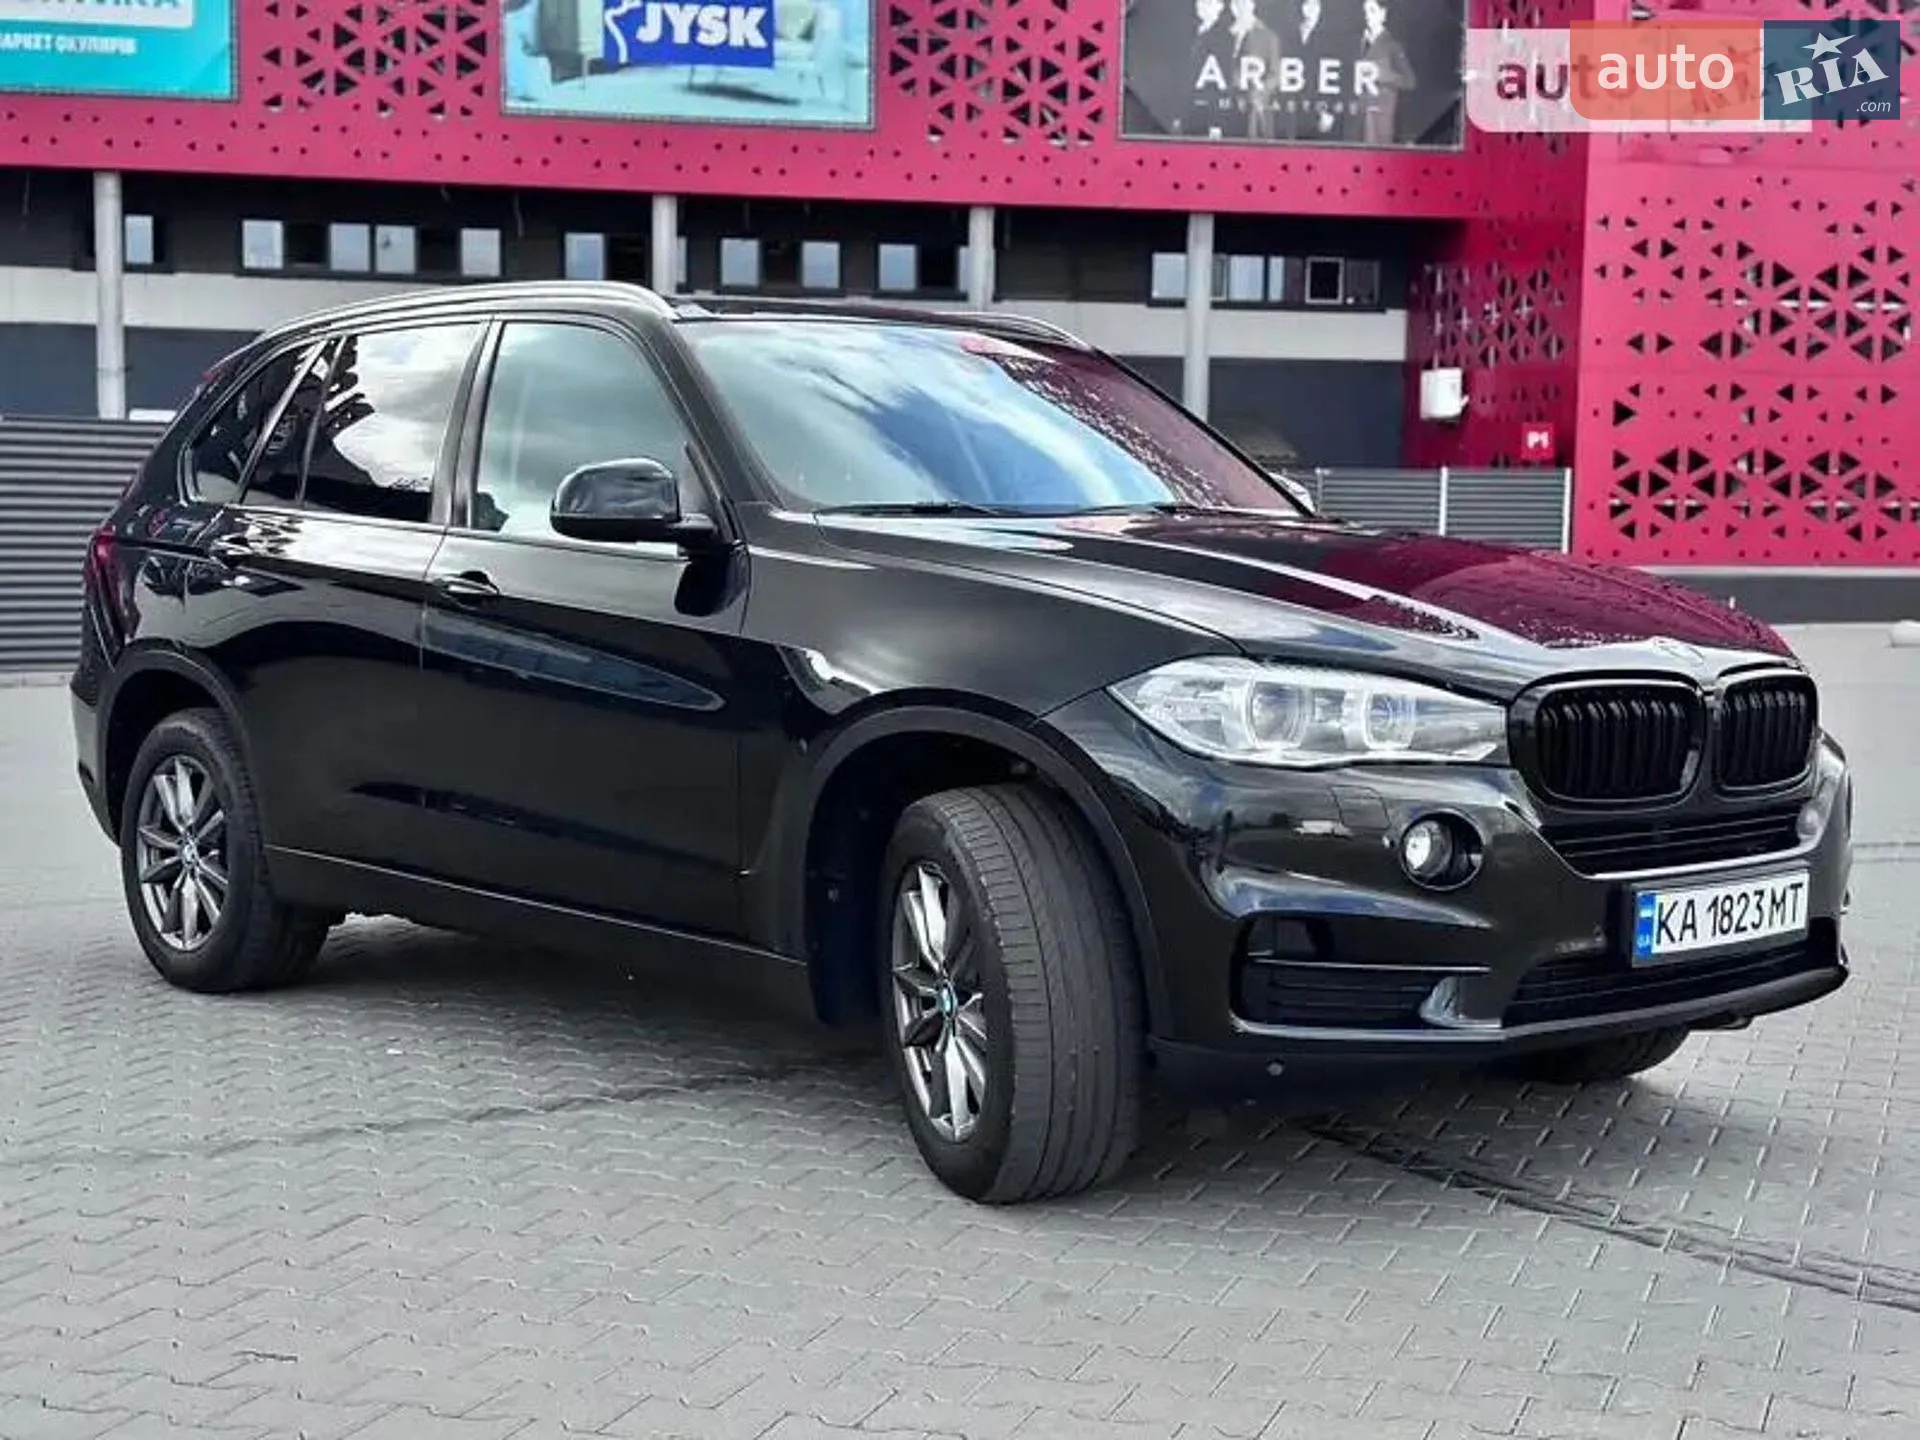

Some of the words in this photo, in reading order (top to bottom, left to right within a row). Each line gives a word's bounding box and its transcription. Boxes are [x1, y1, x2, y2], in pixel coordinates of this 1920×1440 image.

[636, 3, 767, 48] JYSK
[1195, 55, 1381, 96] ARBER
[1655, 899, 1698, 945] KA
[1706, 889, 1765, 937] 1823
[1768, 882, 1804, 928] MT
